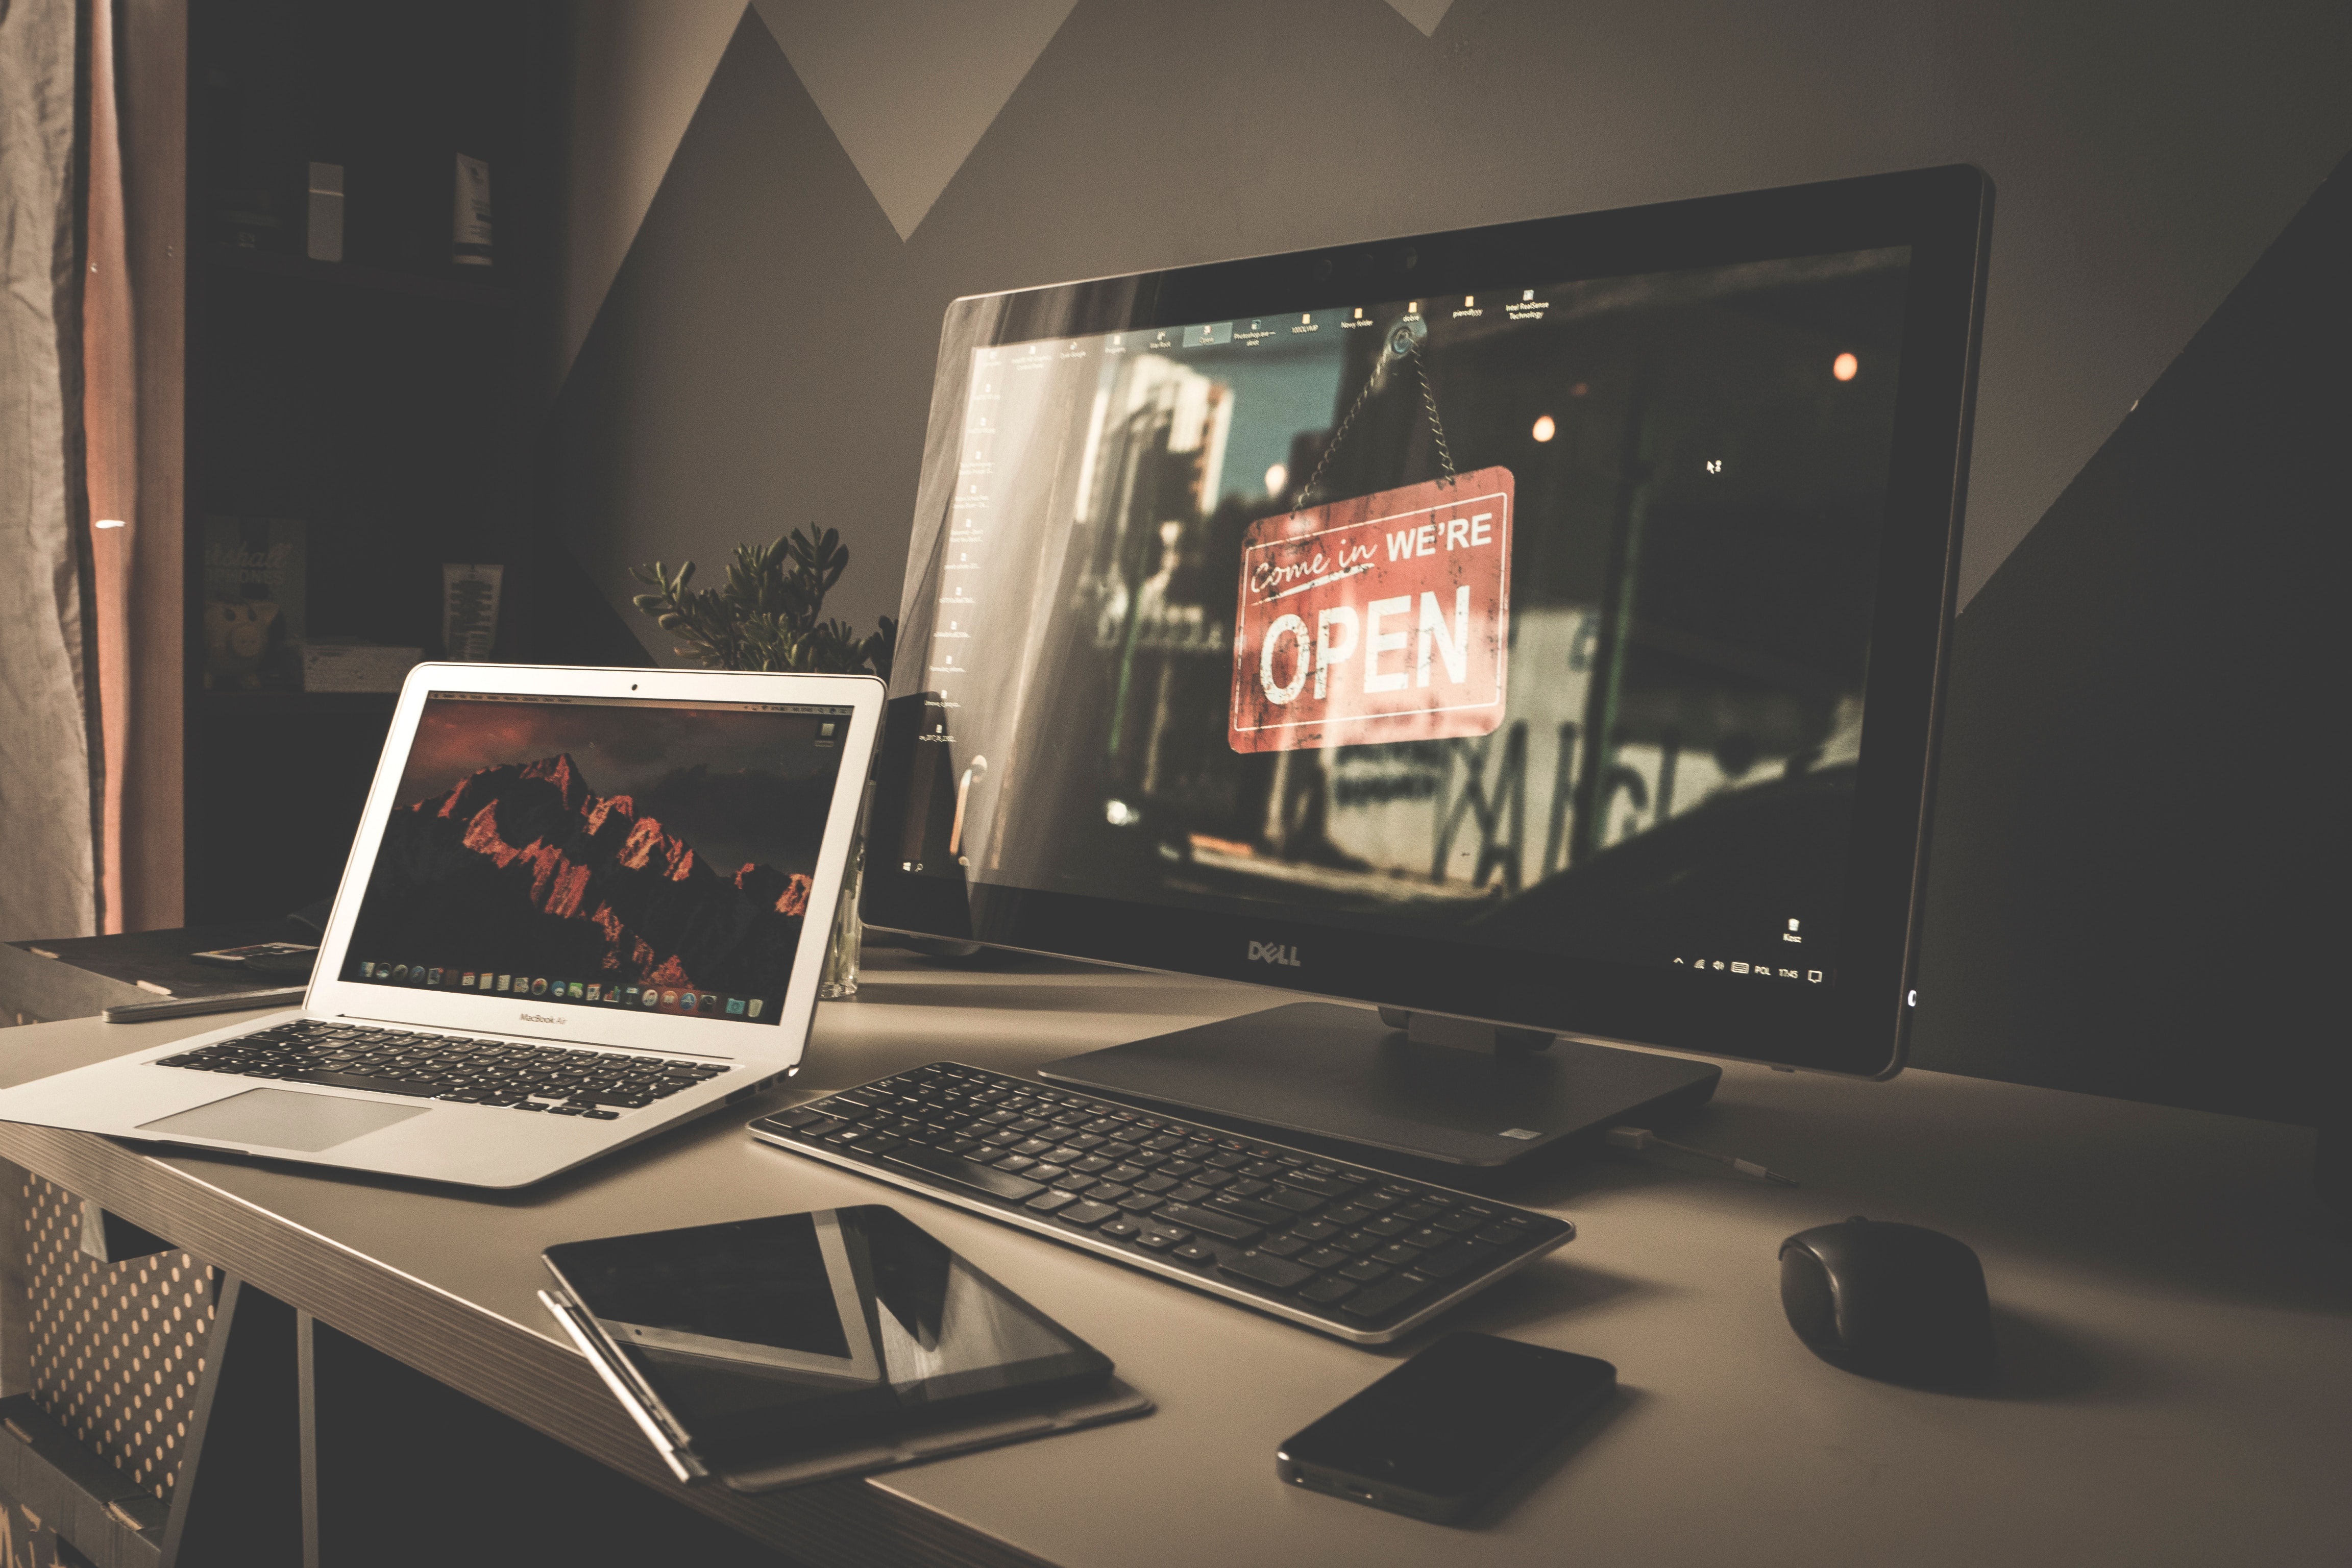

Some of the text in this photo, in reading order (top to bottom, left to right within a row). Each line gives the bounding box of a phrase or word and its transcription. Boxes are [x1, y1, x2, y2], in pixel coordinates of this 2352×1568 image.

[1509, 311, 1544, 320] Technology
[1251, 512, 1492, 593] Come in WE'RE
[1259, 585, 1470, 705] OPEN
[1247, 941, 1301, 966] DELL
[1754, 966, 1771, 975] POL
[520, 1013, 555, 1024] MacBook
